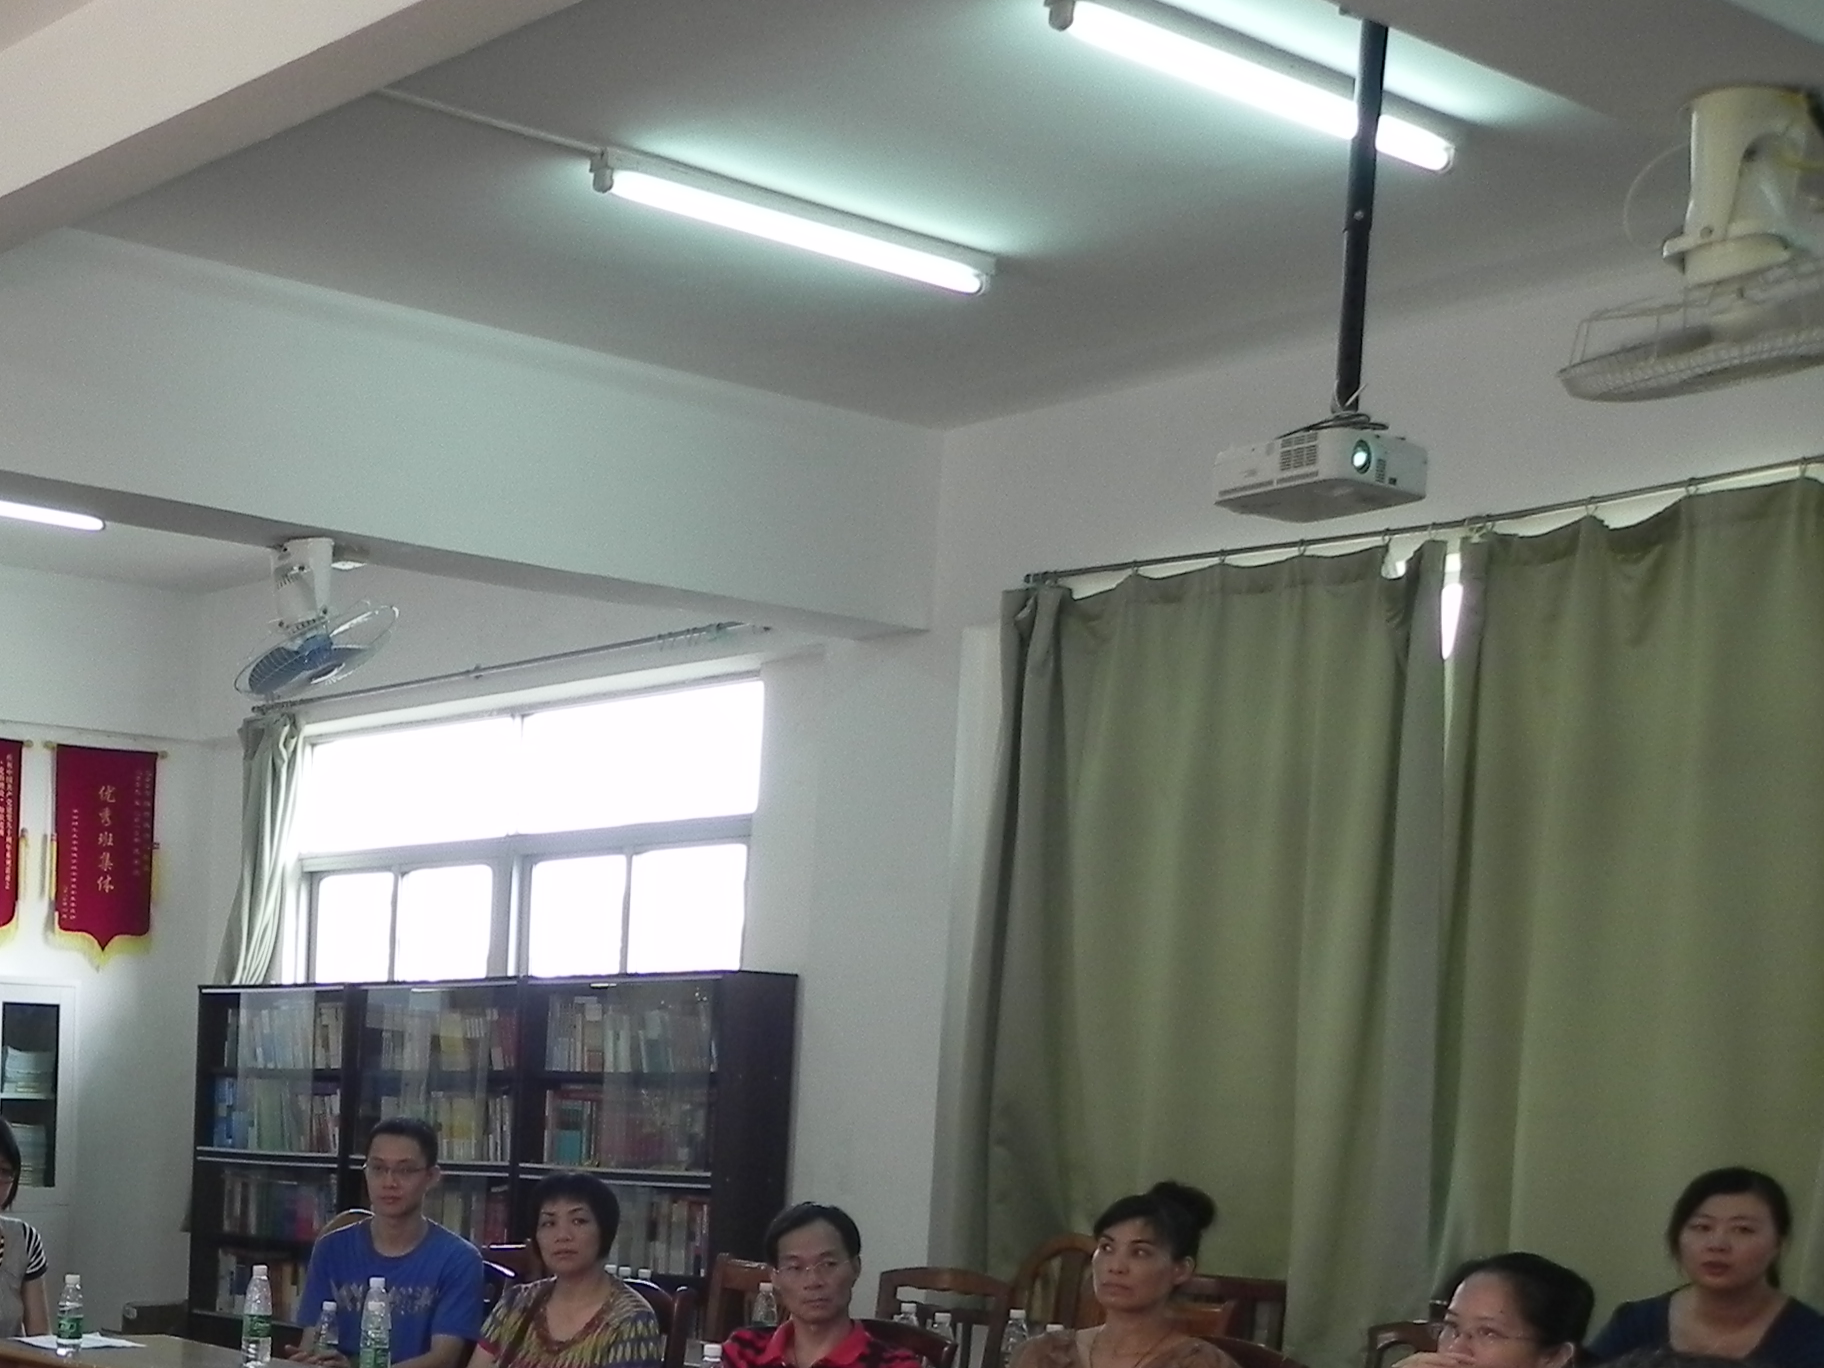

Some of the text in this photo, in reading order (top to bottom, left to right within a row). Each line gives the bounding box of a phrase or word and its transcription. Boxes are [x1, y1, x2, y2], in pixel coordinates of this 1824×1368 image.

[97, 785, 115, 893] 优秀班集体
